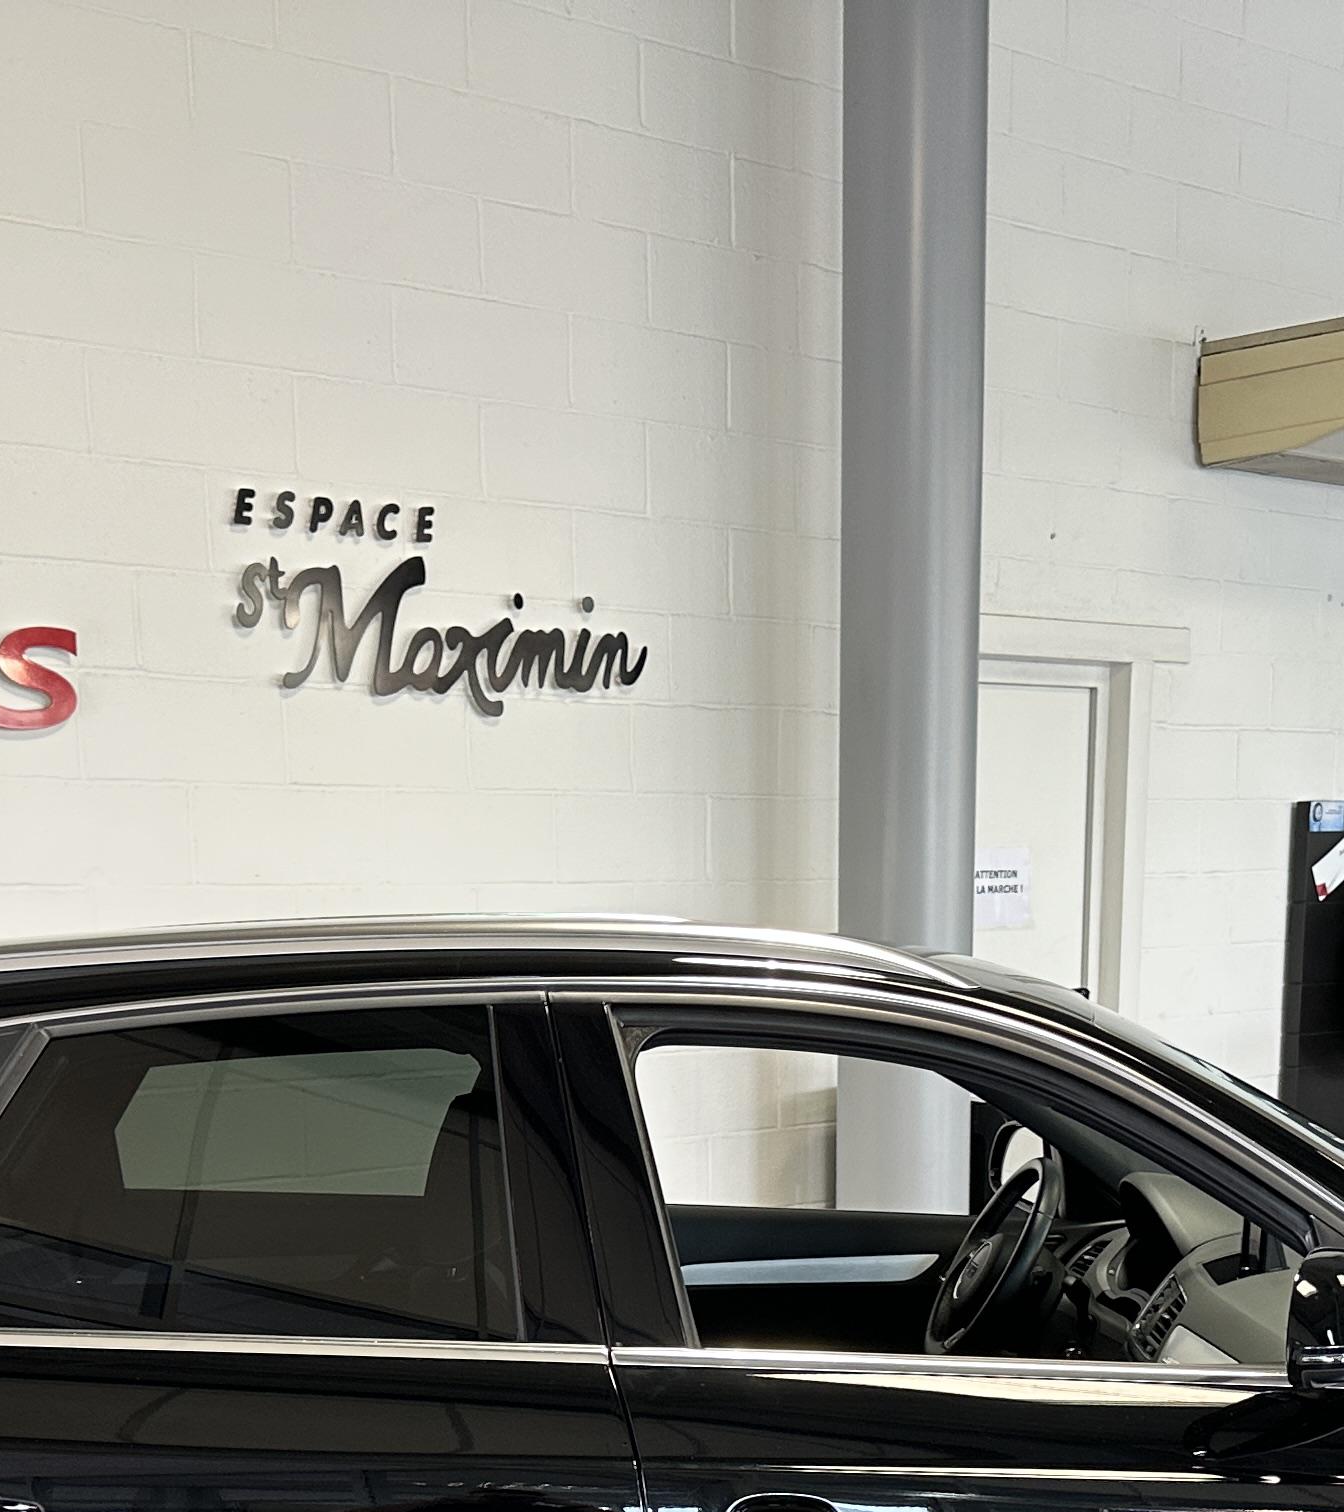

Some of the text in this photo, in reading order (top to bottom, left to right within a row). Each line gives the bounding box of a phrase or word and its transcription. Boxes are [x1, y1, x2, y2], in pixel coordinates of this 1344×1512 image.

[233, 488, 435, 543] ESPACE
[283, 556, 648, 717] Maximin
[975, 870, 1018, 879] ATTENTION
[976, 886, 985, 894] LA
[987, 885, 1018, 893] MARCHE
